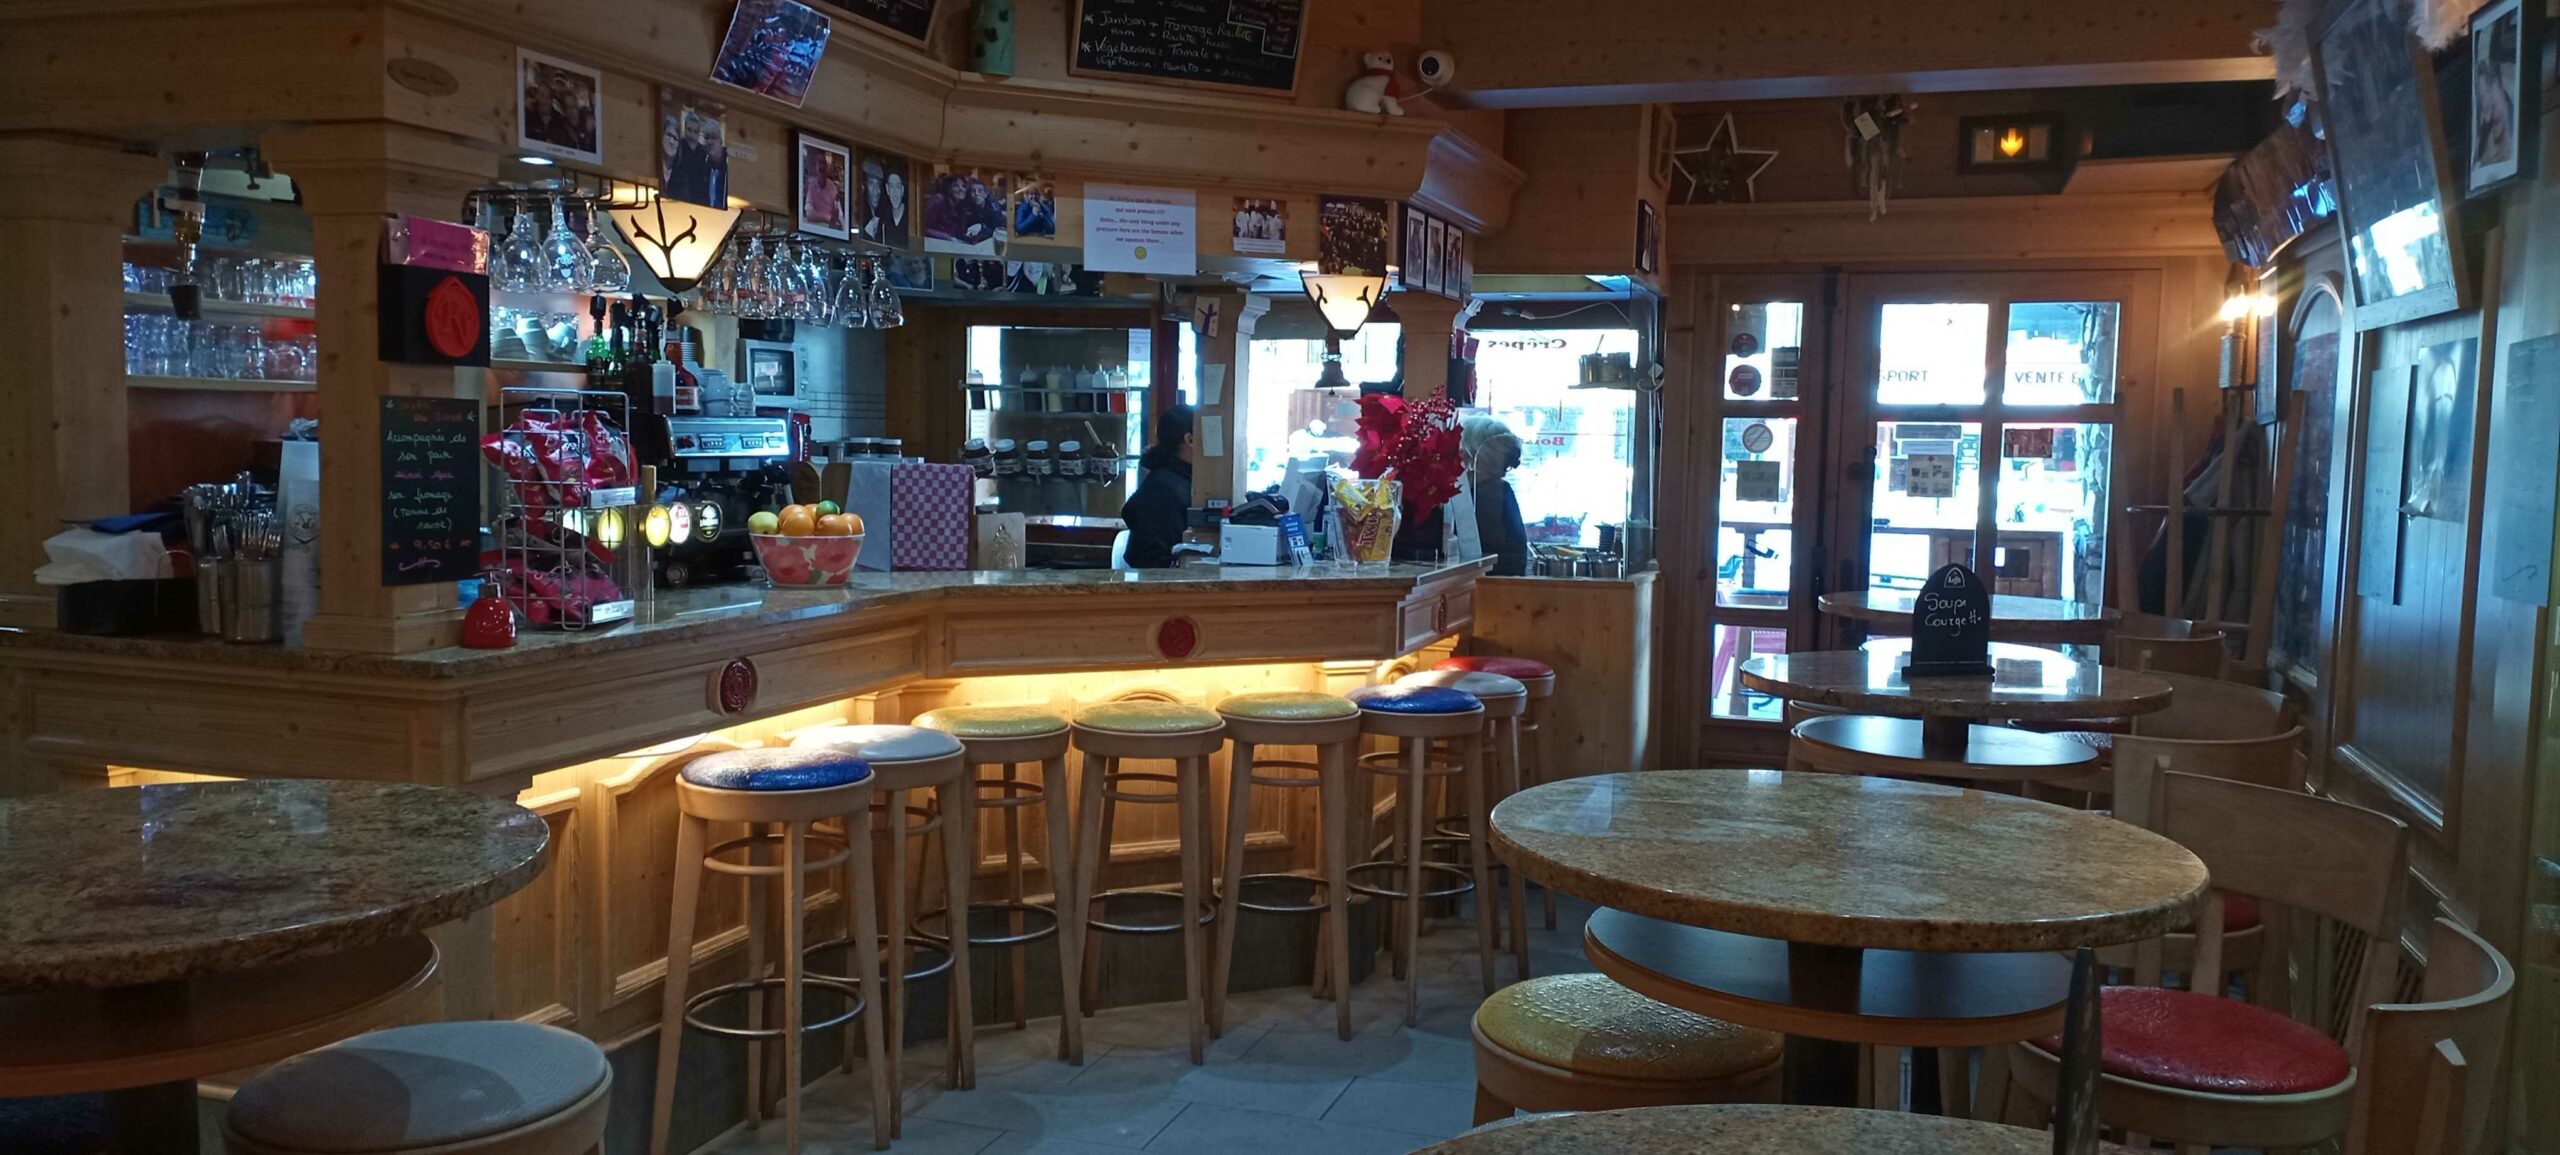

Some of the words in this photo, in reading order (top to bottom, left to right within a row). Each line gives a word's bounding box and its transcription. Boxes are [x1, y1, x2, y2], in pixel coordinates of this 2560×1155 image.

[1099, 11, 1146, 27] Jambon
[1163, 17, 1213, 38] Fromage
[1881, 370, 1929, 383] PORT
[2014, 371, 2065, 384] VENTE
[1924, 592, 1967, 615] Soupe
